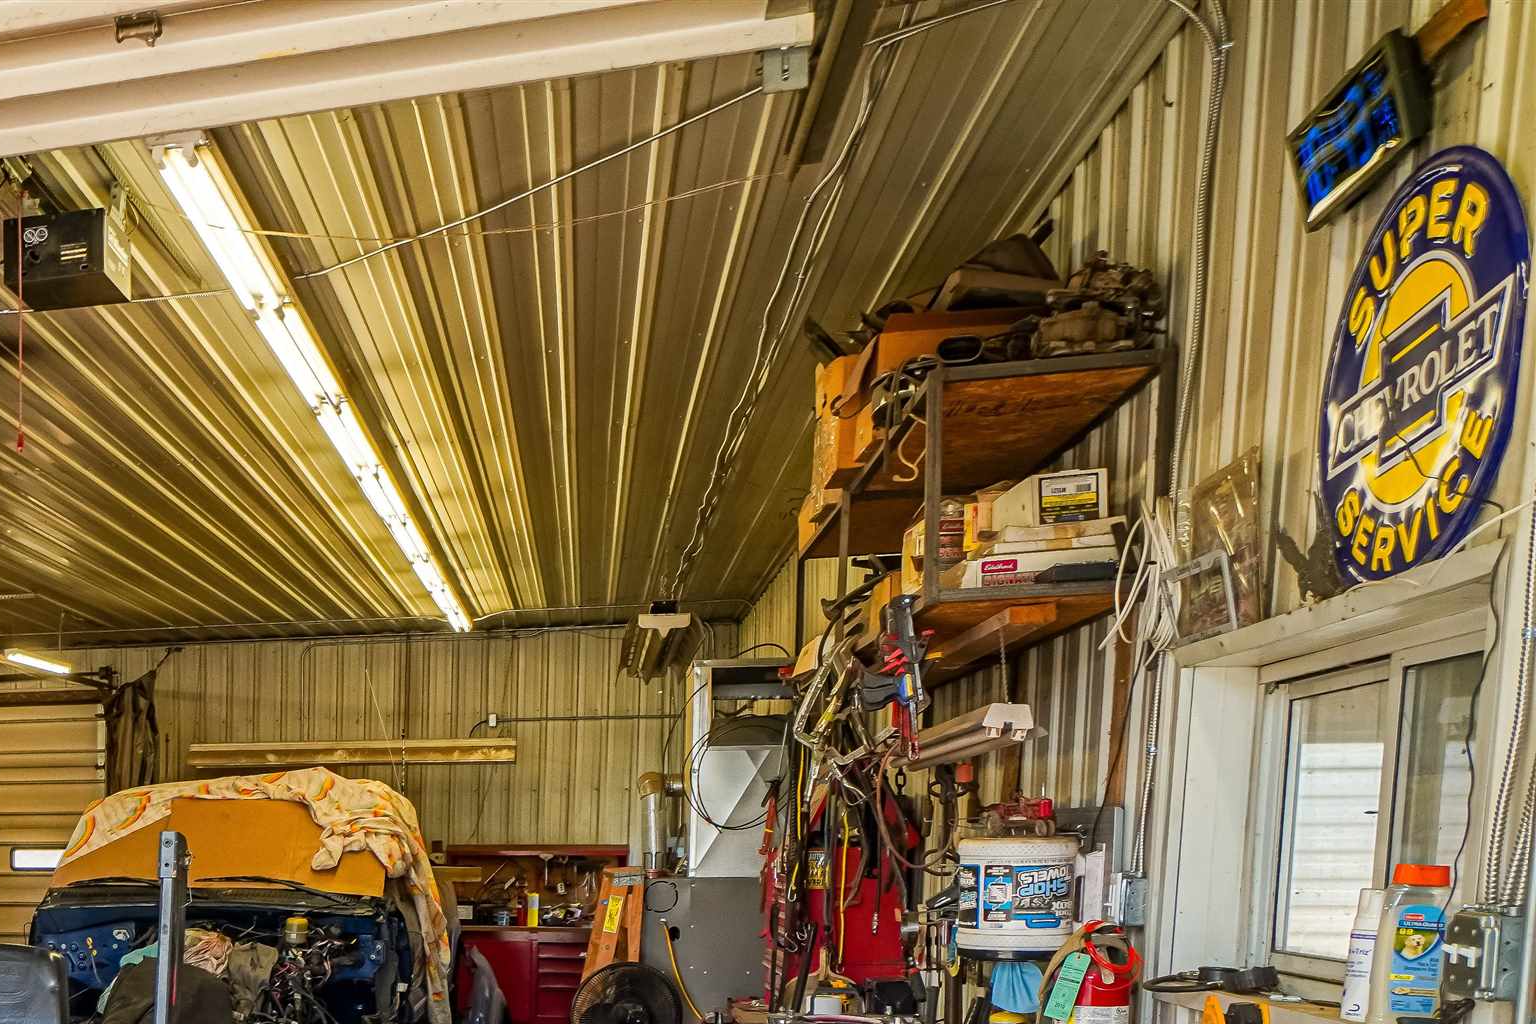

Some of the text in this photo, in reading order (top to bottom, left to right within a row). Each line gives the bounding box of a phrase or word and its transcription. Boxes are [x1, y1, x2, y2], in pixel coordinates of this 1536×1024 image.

[1347, 177, 1490, 351] SUPER
[1336, 302, 1500, 455] CHEVROLET
[1335, 408, 1494, 573] SERVICE
[1018, 864, 1072, 883] TOWELS
[1018, 879, 1068, 897] SHOP
